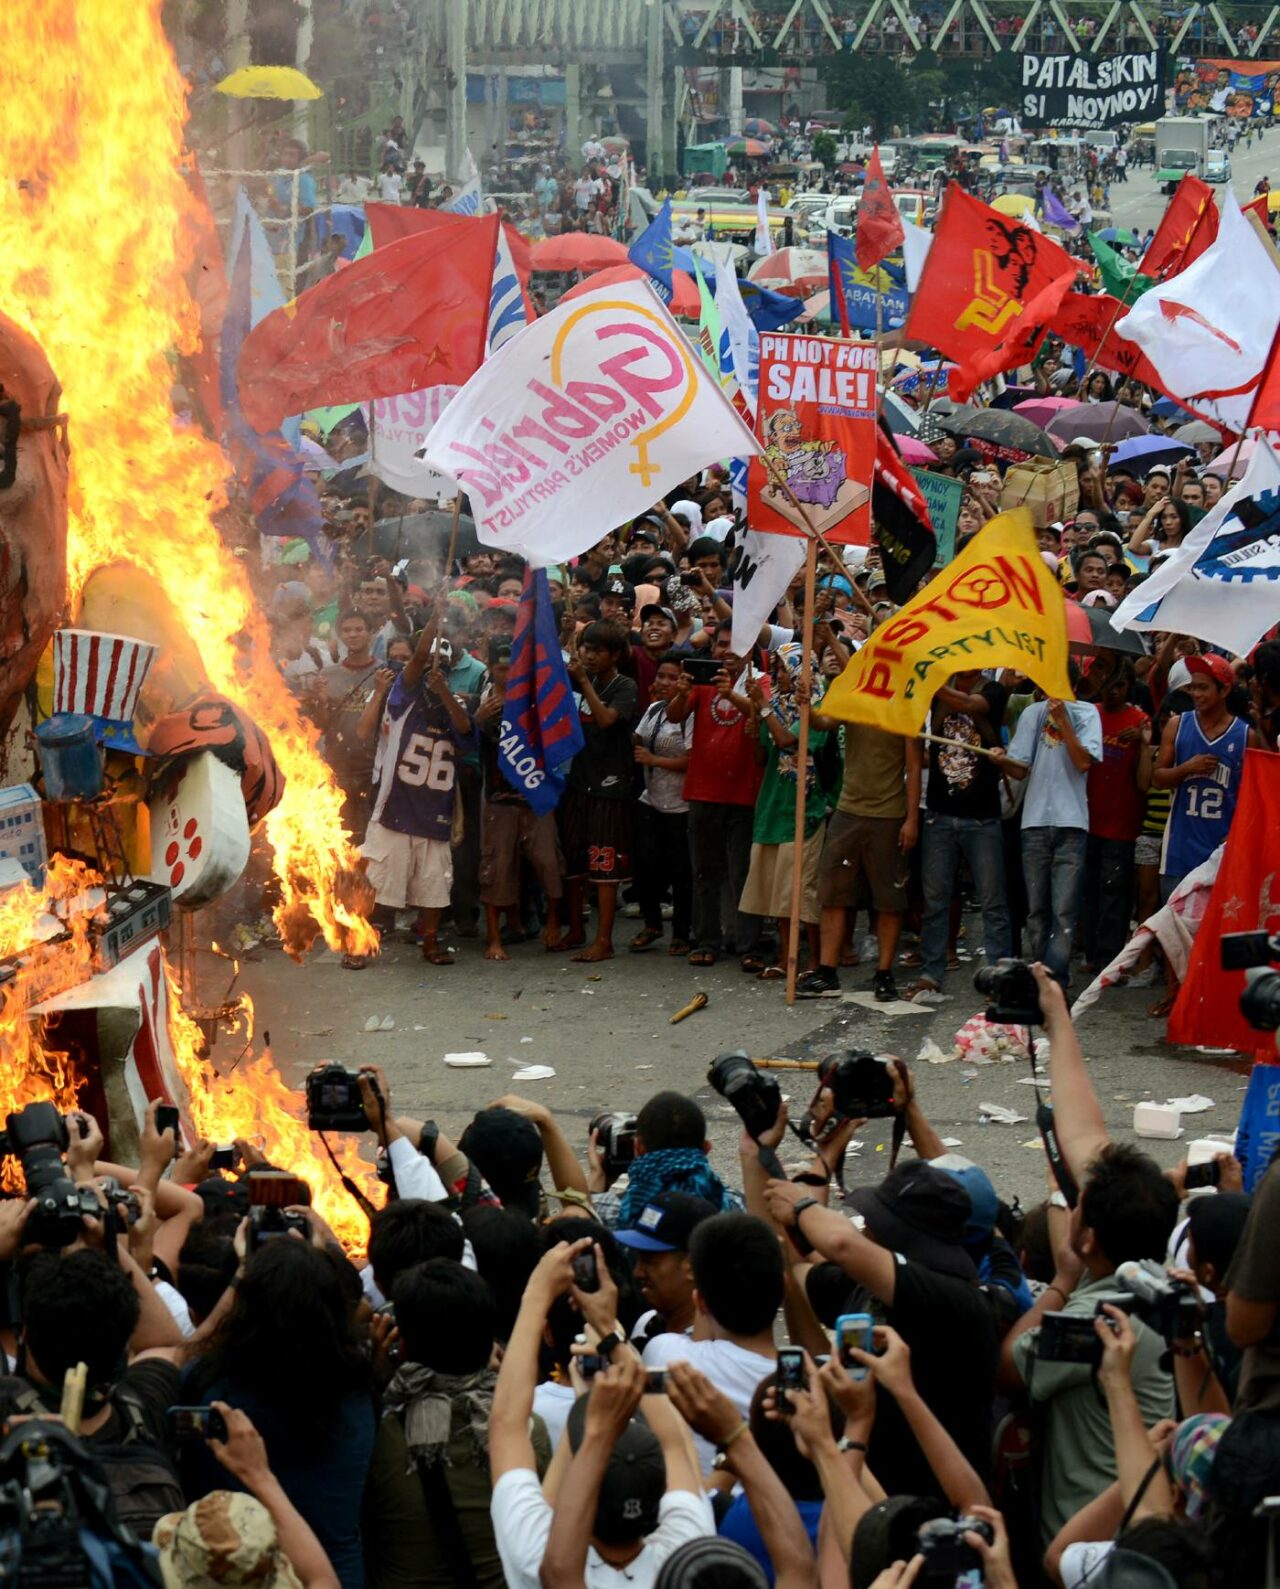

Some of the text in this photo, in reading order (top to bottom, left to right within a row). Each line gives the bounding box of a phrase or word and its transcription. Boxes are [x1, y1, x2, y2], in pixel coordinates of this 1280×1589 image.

[1022, 52, 1157, 90] PATALSIKIN
[1024, 85, 1158, 121] SI NOYNOY!
[842, 288, 904, 310] ABATAAN
[762, 337, 878, 371] PH NOT FOR
[767, 363, 869, 409] SALE!
[860, 556, 1045, 700] PISTON
[398, 733, 455, 792] 56
[1186, 785, 1224, 819] 12
[587, 846, 615, 871] 23
